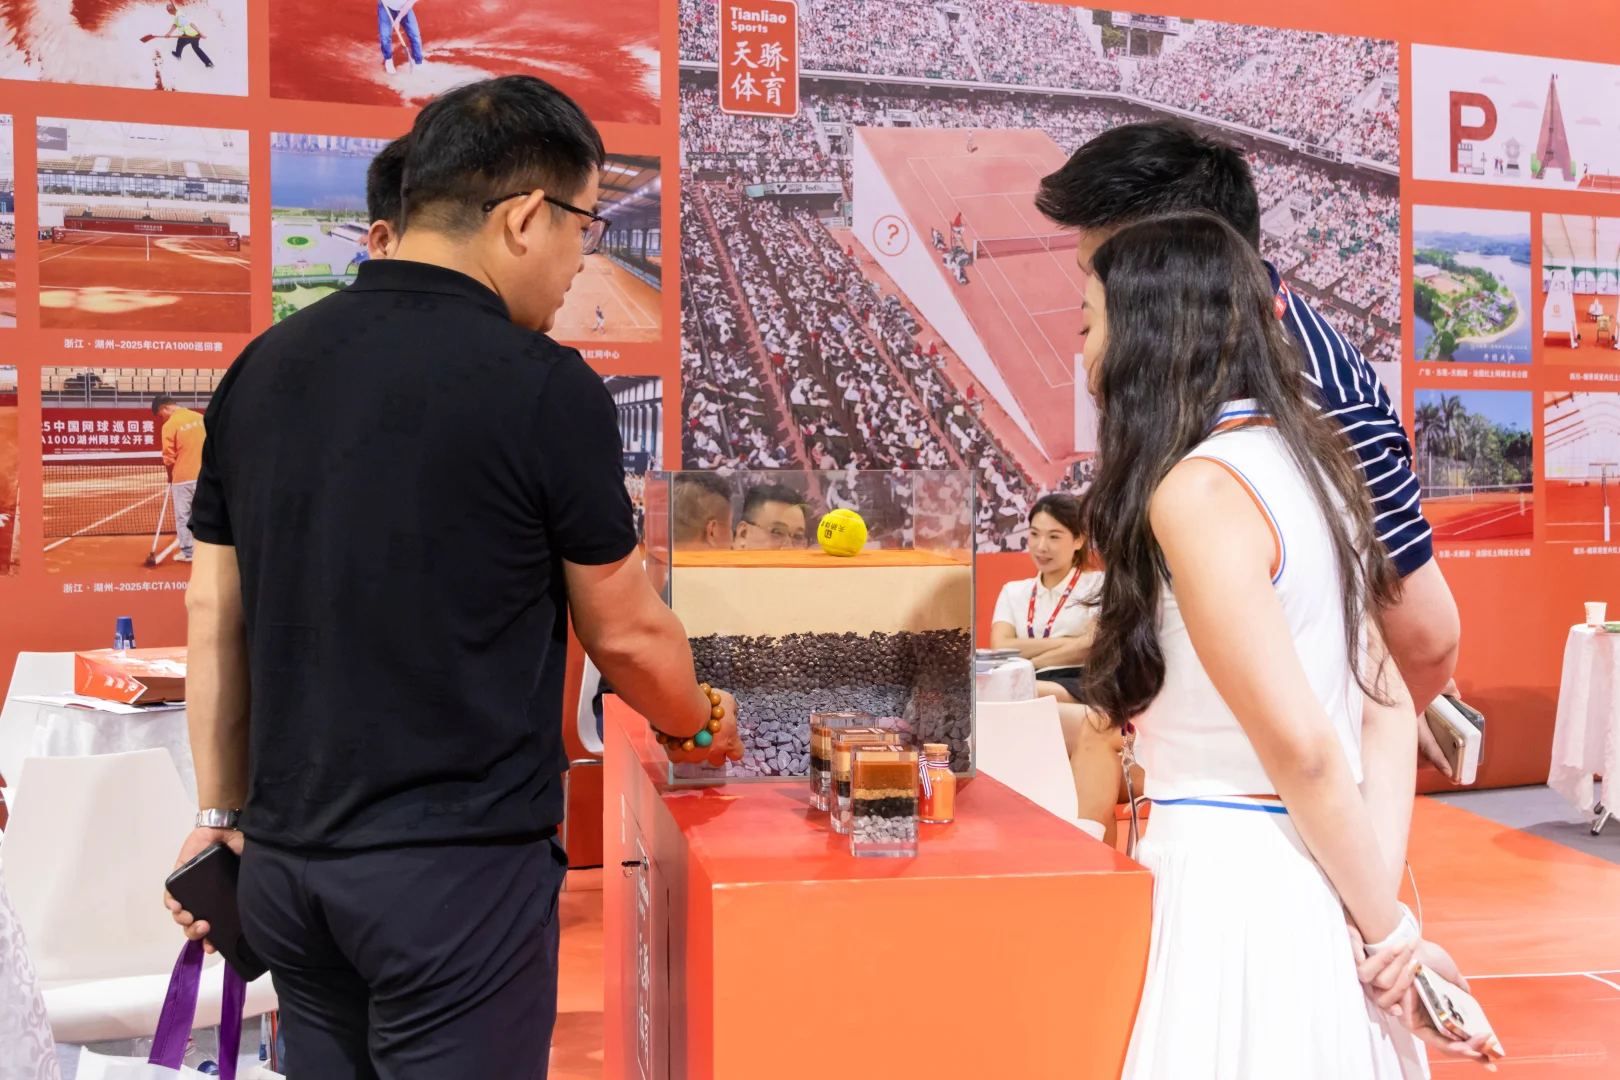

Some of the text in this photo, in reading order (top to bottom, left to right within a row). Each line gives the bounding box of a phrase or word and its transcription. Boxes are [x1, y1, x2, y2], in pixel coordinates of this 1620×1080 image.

[731, 21, 768, 34] Sports
[730, 41, 789, 72] 天骄
[731, 72, 787, 107] 体育
[63, 582, 190, 594] 浙江·湖州-2025年CTA100
